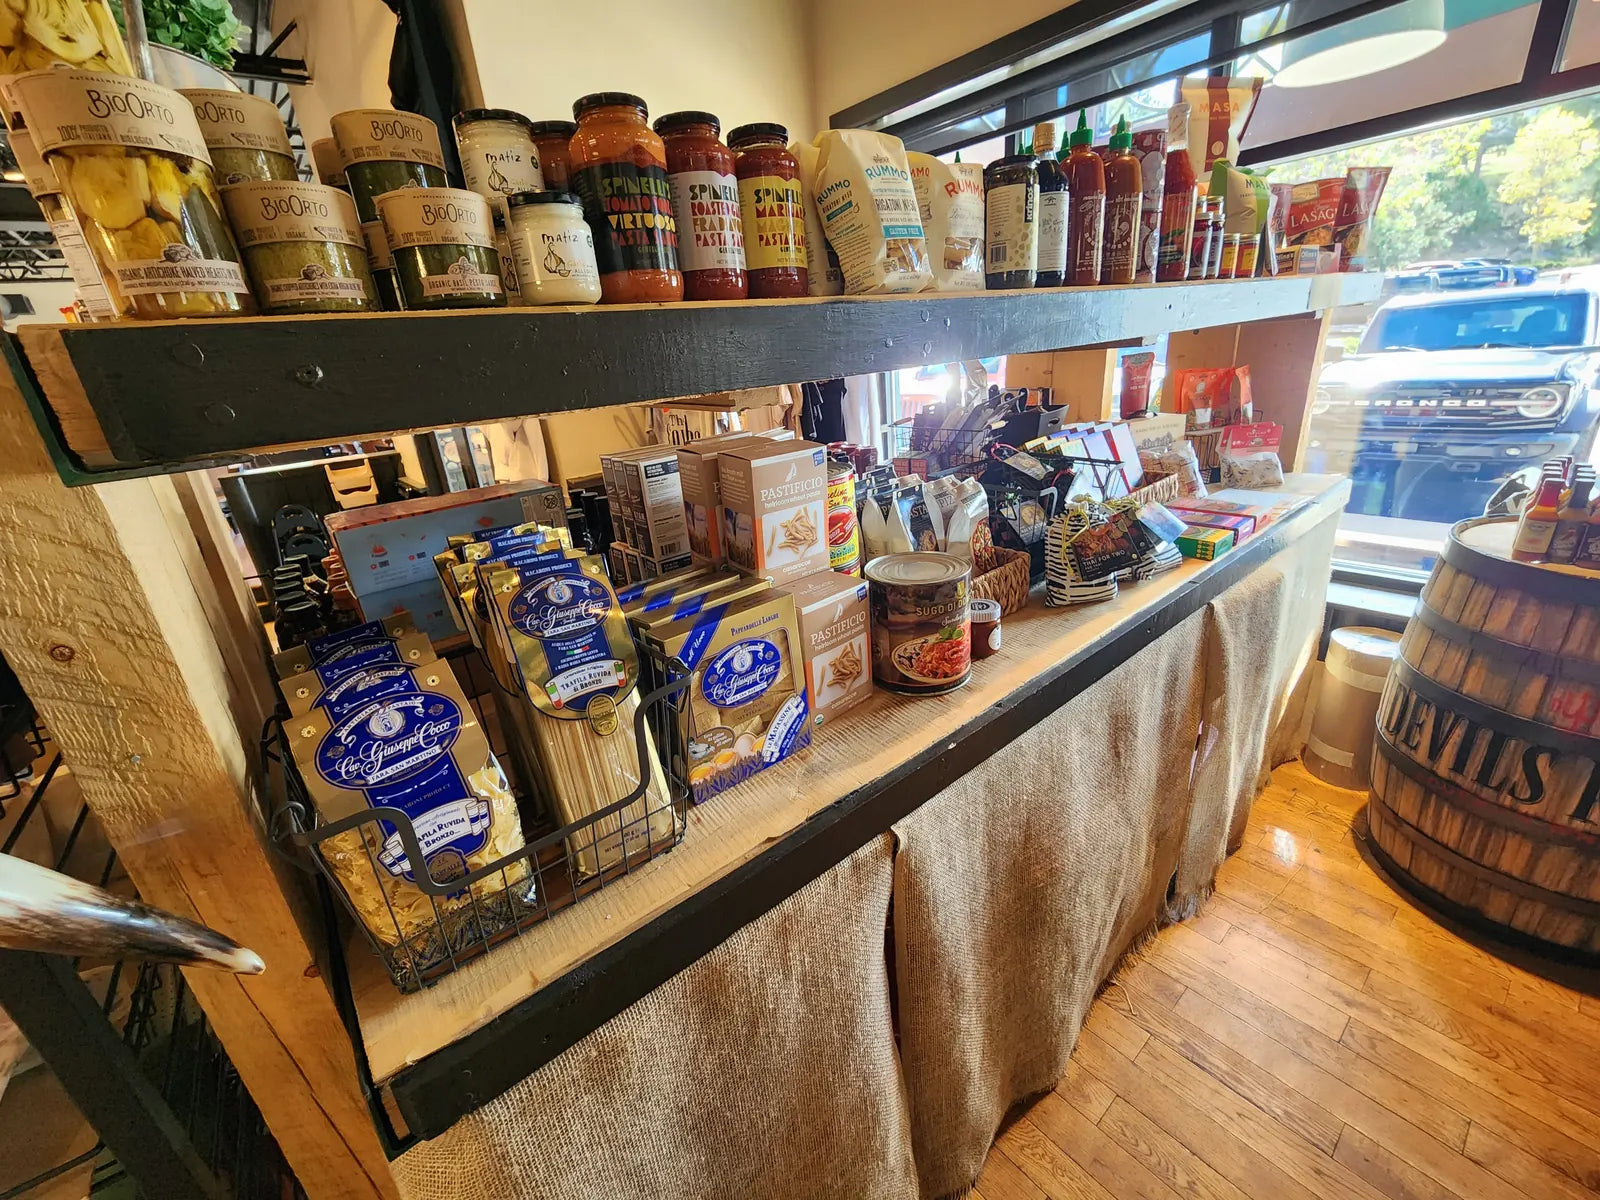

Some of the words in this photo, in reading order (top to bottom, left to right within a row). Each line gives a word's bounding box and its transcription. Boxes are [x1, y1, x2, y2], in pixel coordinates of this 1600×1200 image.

[1200, 102, 1240, 113] MASA
[485, 151, 522, 164] matiz
[865, 165, 909, 181] RUMMO
[817, 179, 851, 205] RUMMO
[690, 201, 730, 217] ROASTED
[1026, 186, 1034, 221] krinos
[607, 213, 676, 233] VIRTUOSO
[1291, 207, 1338, 228] LASAG
[541, 230, 579, 244] matiz
[611, 230, 650, 247] PASTA
[695, 232, 727, 248] PASTA
[758, 232, 790, 247] PASTA
[144, 267, 181, 280] ARTICHOKE
[181, 266, 206, 278] HALVED
[428, 281, 452, 289] ORGANIC
[453, 279, 469, 287] BASIL
[760, 476, 823, 501] PASTIFICIO
[910, 506, 929, 520] ASTA
[1082, 557, 1099, 568] THAI
[1112, 549, 1126, 557] TWO
[525, 567, 551, 577] MACARONI
[551, 563, 573, 571] PRODUCT
[916, 604, 944, 616] SUGO
[947, 602, 957, 613] DI
[810, 611, 866, 646] PASTIFICIO
[560, 675, 587, 691] TRAFILA
[588, 670, 612, 679] RUVIDA
[579, 679, 603, 690] BRONZO
[343, 704, 379, 735] ARTIGIANO
[387, 700, 416, 710] PASTAIO
[768, 706, 792, 743] MATASSINE
[335, 755, 362, 780] Cav.
[360, 735, 420, 778] Giuseppe
[414, 721, 452, 749] Cocco
[371, 770, 391, 782] FARA
[391, 763, 406, 773] SAN
[406, 748, 438, 766] MARTINO
[417, 828, 438, 843] AFILA
[437, 817, 466, 832] RUVIDA
[424, 830, 455, 848] BRONZO
